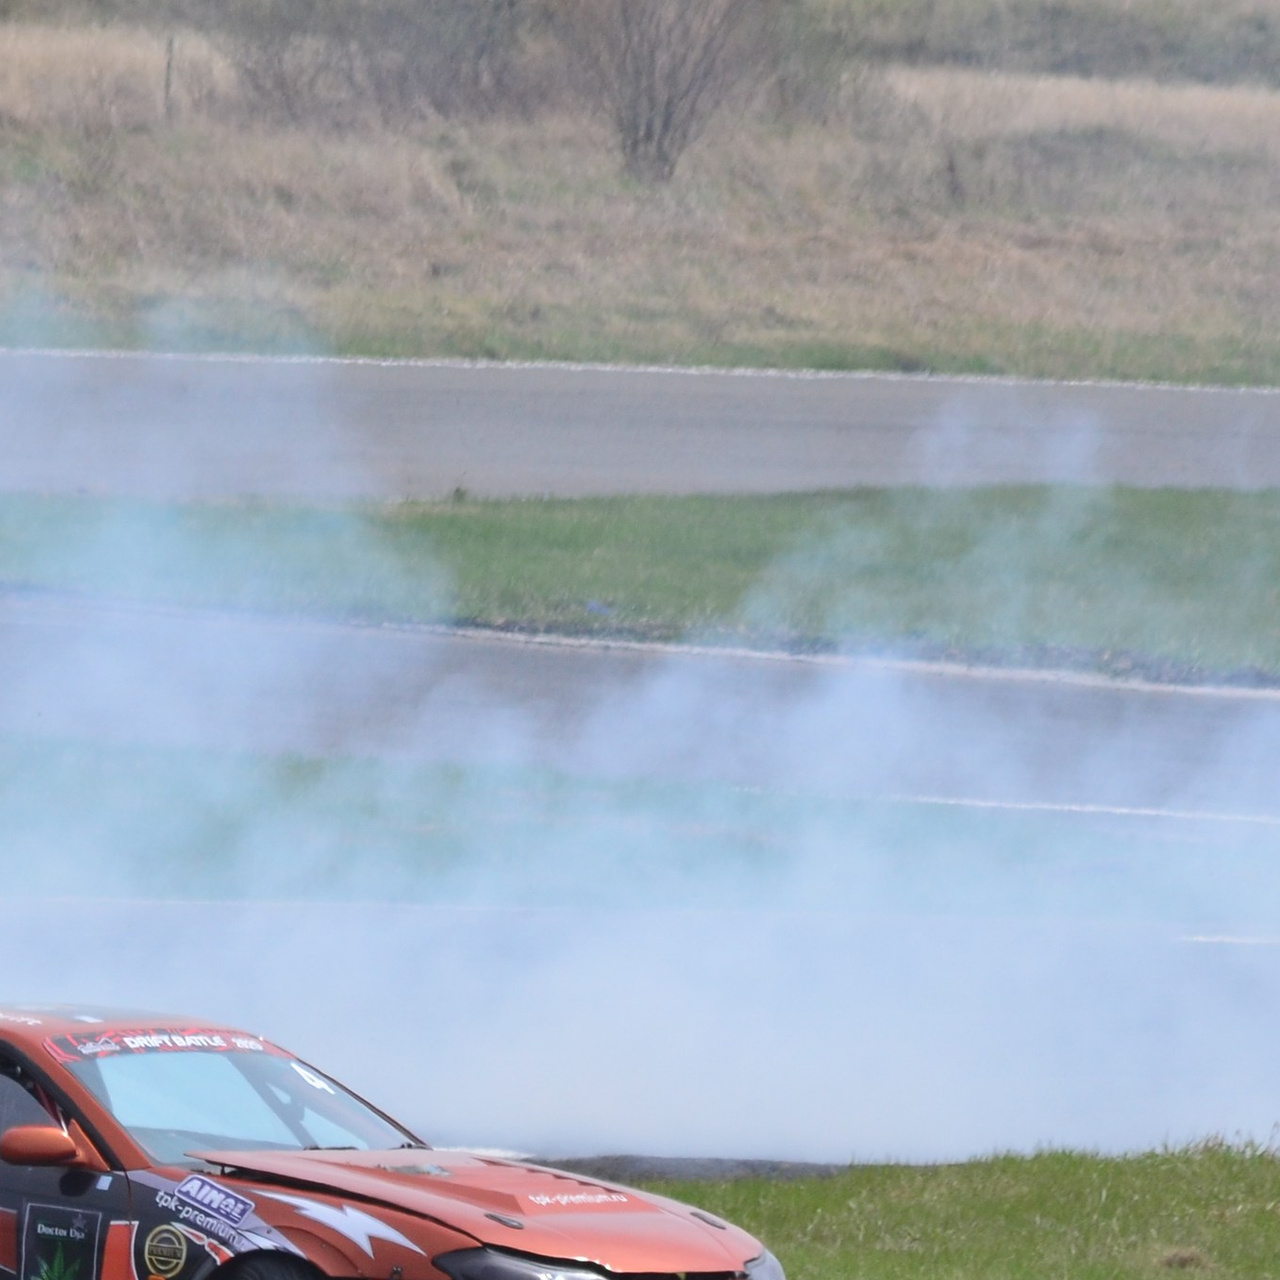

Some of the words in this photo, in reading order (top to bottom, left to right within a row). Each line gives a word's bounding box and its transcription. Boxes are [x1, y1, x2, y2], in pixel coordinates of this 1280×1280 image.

[123, 1035, 171, 1049] DRIFT
[170, 1035, 226, 1048] BATTLE
[180, 1178, 246, 1217] AIMOL
[37, 1223, 67, 1237] Doctor
